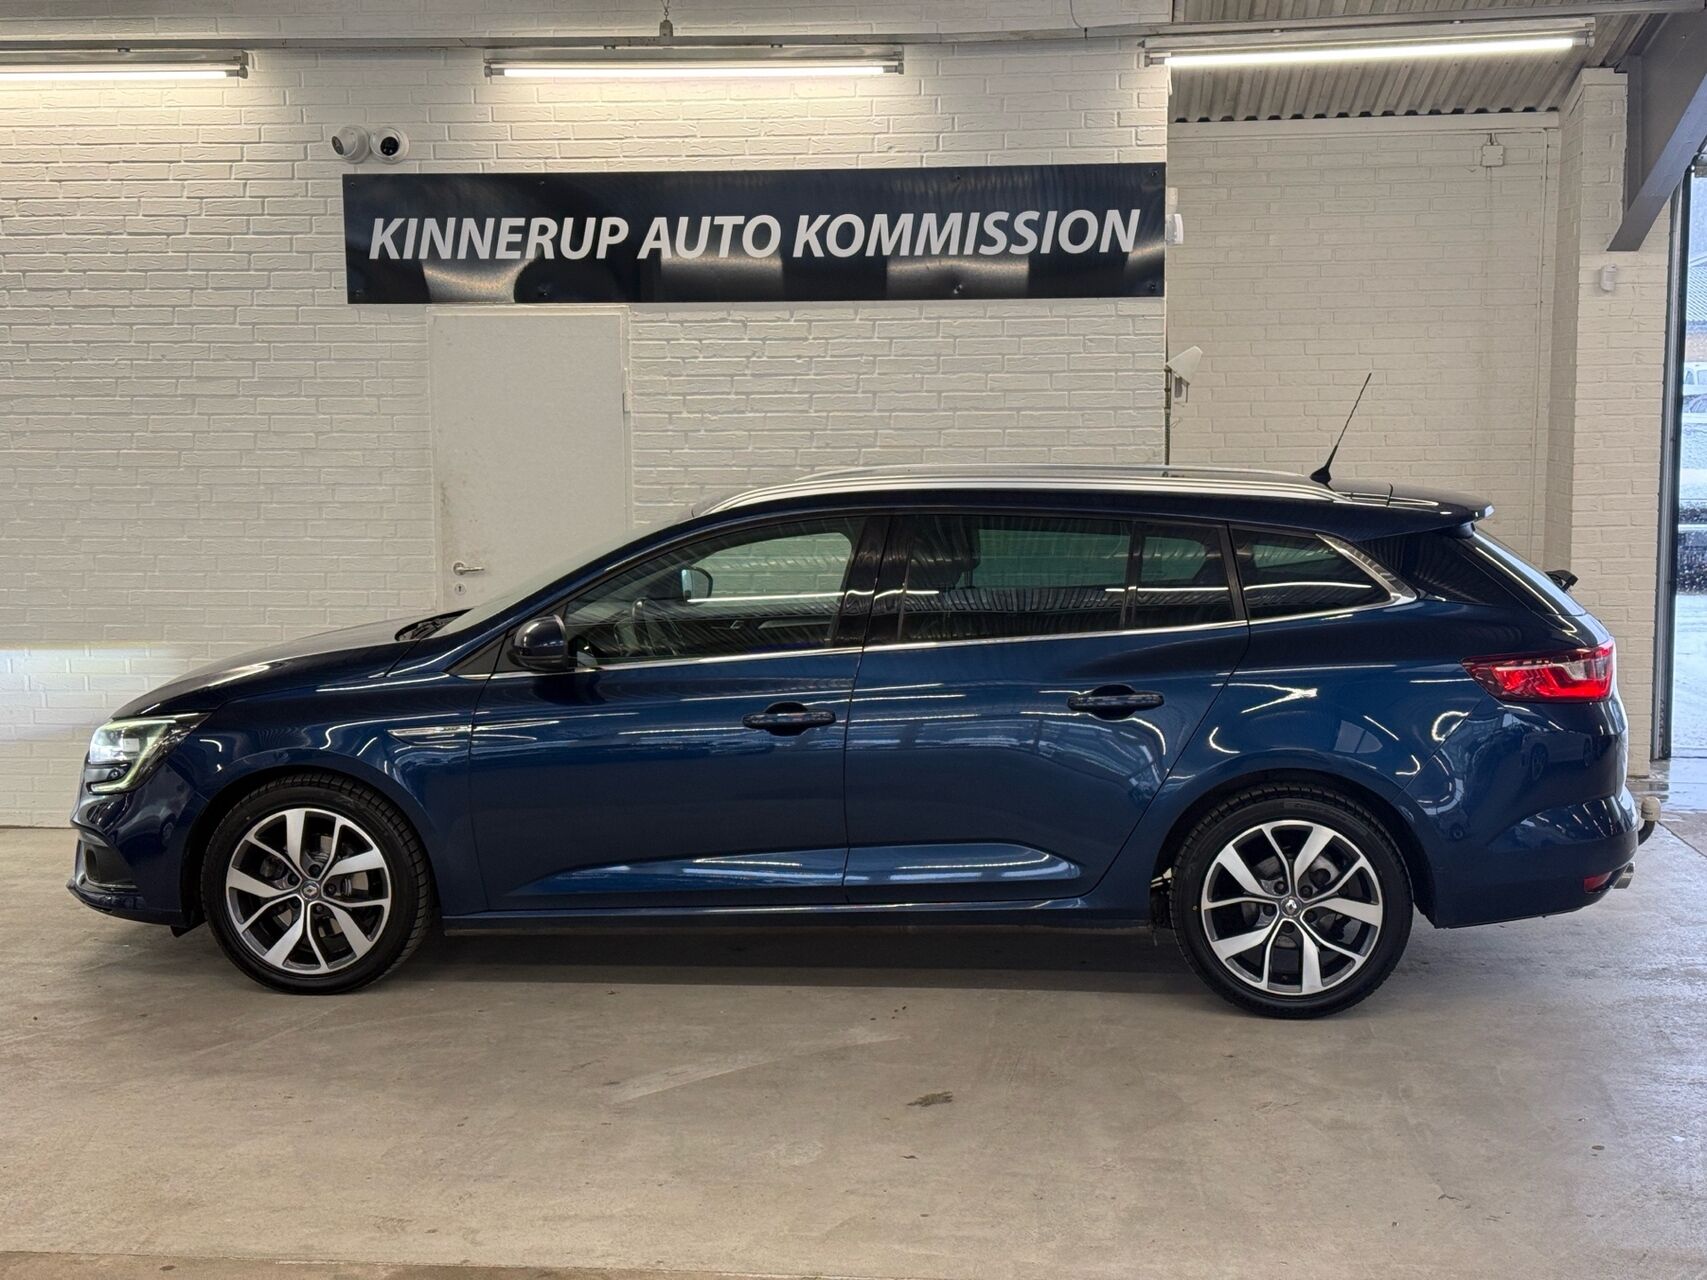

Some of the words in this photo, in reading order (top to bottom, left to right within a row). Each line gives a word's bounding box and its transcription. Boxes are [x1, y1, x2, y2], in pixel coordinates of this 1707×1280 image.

[369, 217, 629, 260] KINNERUP
[637, 215, 782, 260] AUTO
[792, 209, 1141, 258] KOMMISSION
